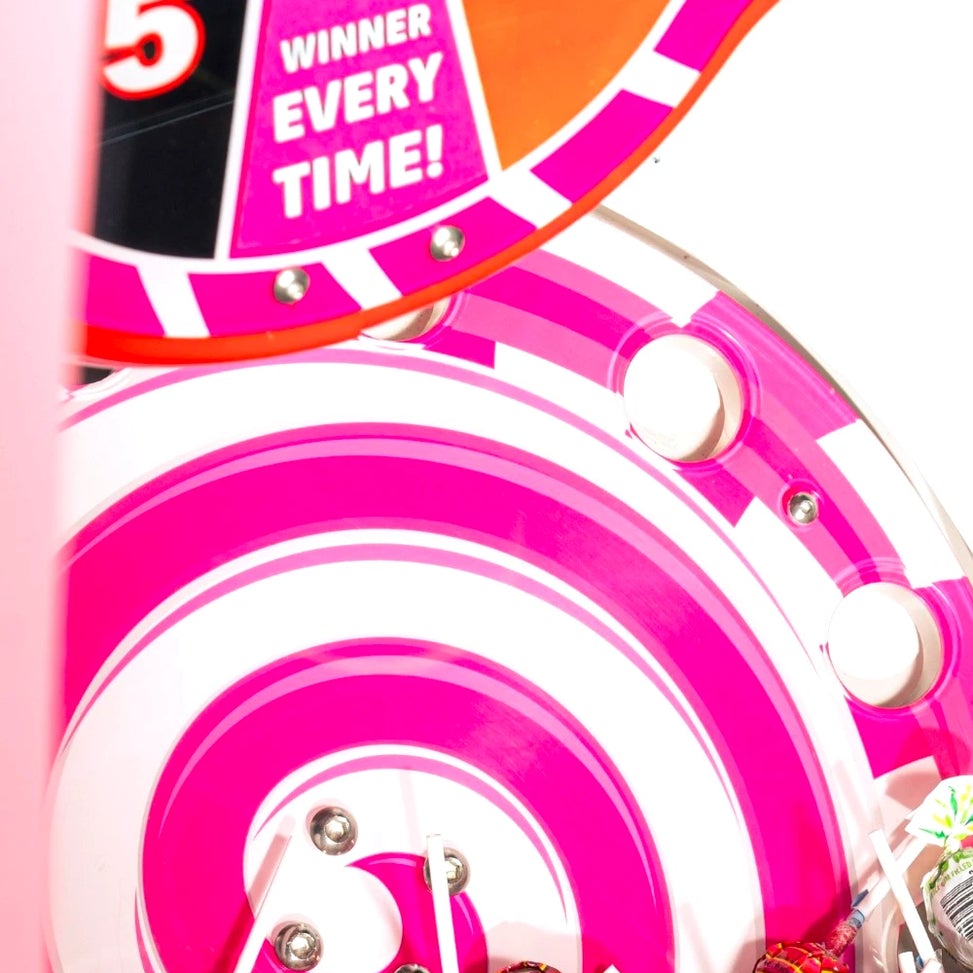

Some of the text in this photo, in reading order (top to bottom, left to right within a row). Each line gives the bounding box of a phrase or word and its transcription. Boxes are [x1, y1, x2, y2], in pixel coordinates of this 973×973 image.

[98, 0, 206, 99] 5
[279, 3, 433, 74] WINNER
[272, 51, 444, 144] EVERY
[271, 123, 444, 219] TIME!
